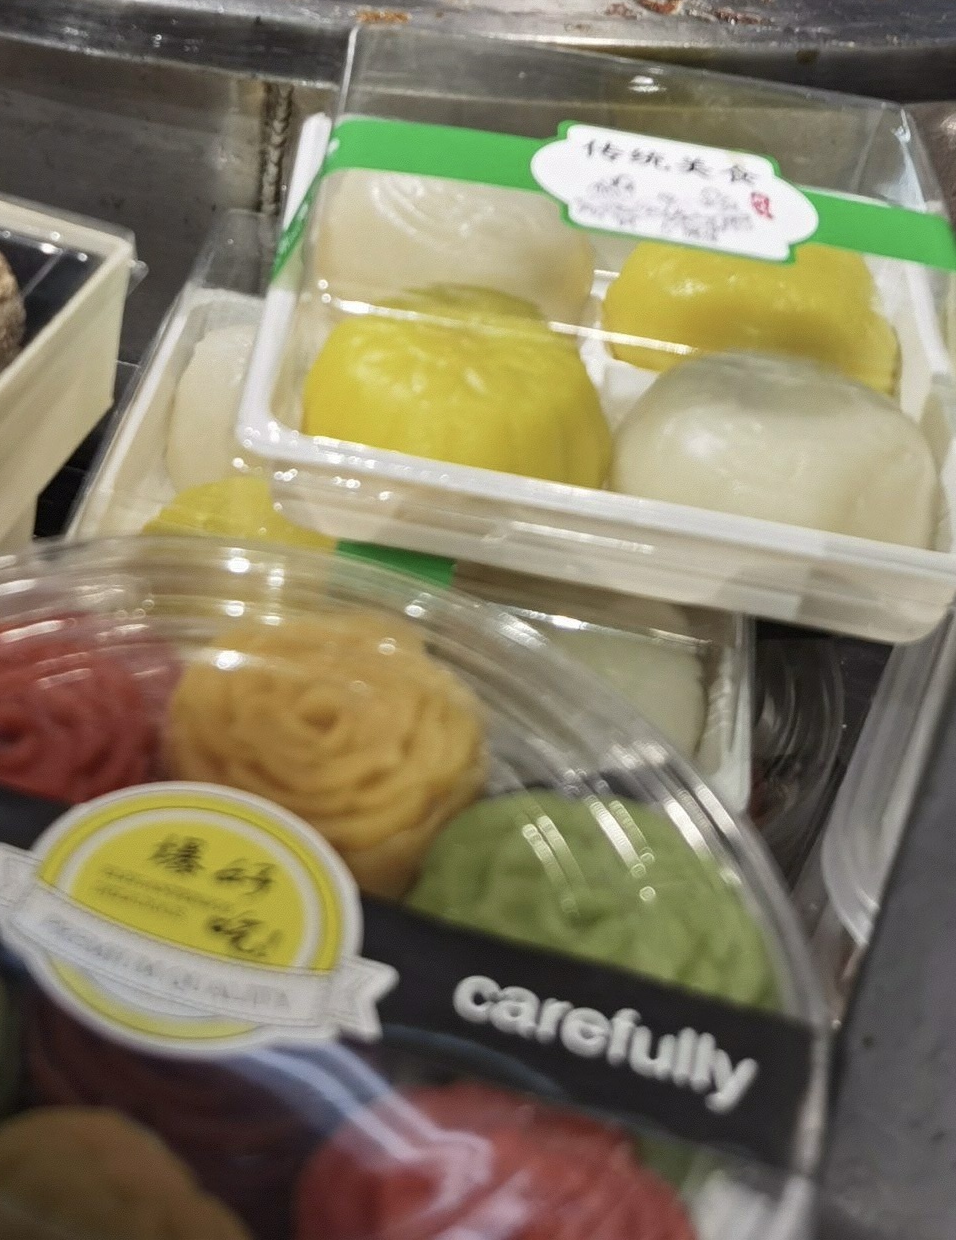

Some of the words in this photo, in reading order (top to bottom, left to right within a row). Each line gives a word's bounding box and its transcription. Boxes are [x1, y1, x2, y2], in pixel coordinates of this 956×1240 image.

[582, 139, 761, 187] 传统美食
[453, 975, 758, 1114] carefully
